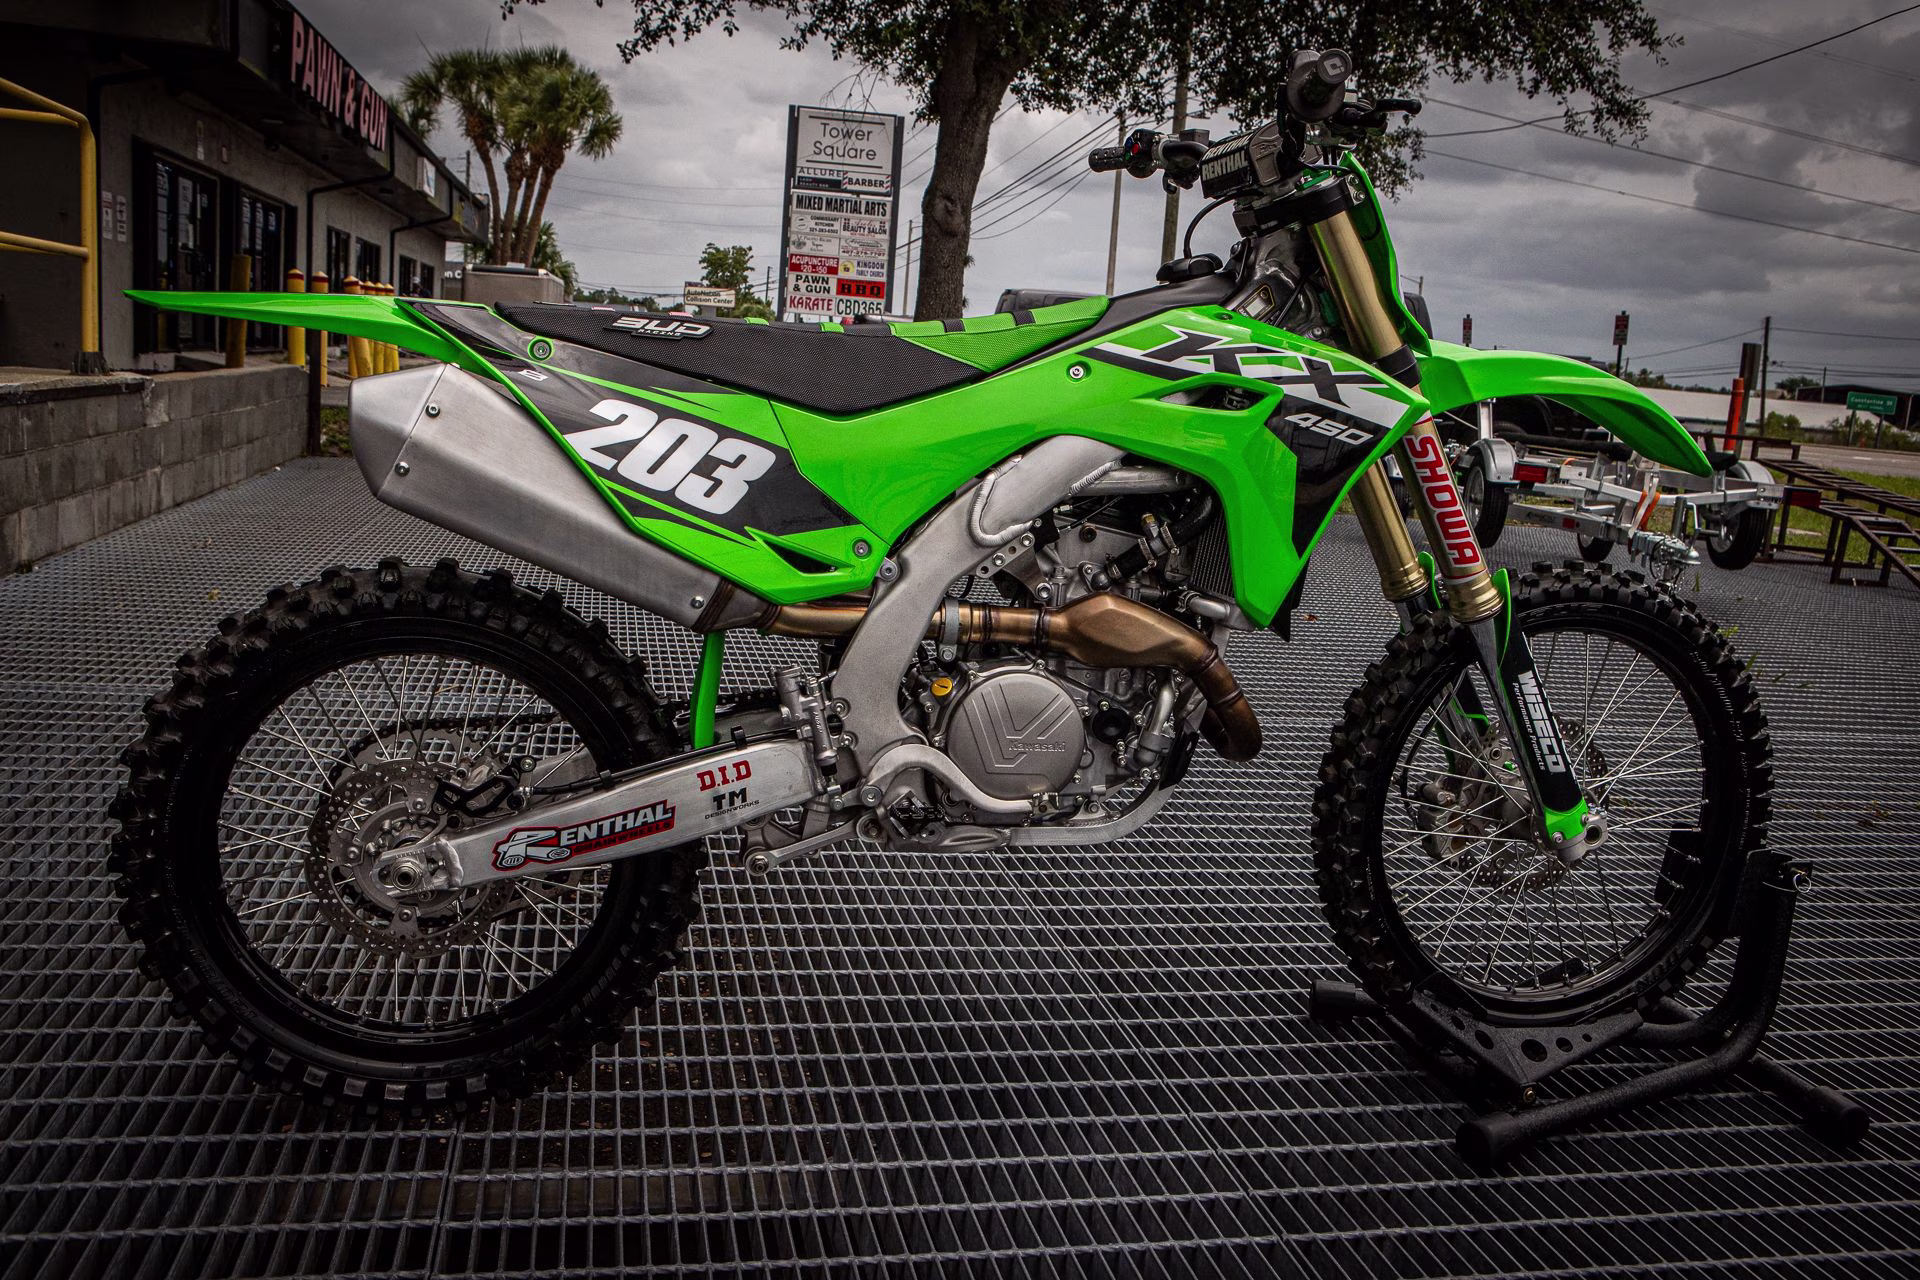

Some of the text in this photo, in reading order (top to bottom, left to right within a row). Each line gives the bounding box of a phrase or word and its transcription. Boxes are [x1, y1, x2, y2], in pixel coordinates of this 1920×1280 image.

[291, 11, 388, 151] PAWN & GUN
[820, 122, 873, 141] Tower
[813, 140, 877, 160] Square
[798, 167, 841, 178] ALLURE
[1202, 150, 1249, 181] RENTHAL
[848, 177, 885, 188] BARBER
[796, 195, 887, 217] MIXED MARTIAL ARTS
[842, 224, 887, 235] BEAUTY SALON
[791, 255, 838, 267] ACUPUNCTURE
[856, 260, 885, 270] KINGDOM
[792, 284, 831, 294] & GUN
[795, 274, 830, 285] PAWN
[686, 295, 734, 305] Collision Center
[789, 295, 833, 311] KARATE
[837, 298, 882, 316] CBD365
[1284, 412, 1375, 445] 450
[563, 399, 777, 514] 203
[1402, 435, 1481, 567] SHOWA
[1512, 682, 1546, 771] Performance Products
[1008, 740, 1066, 752] Kawasaki
[697, 760, 752, 791] D.I.D
[713, 787, 747, 810] TM
[704, 800, 760, 820] DESIGNWORKS
